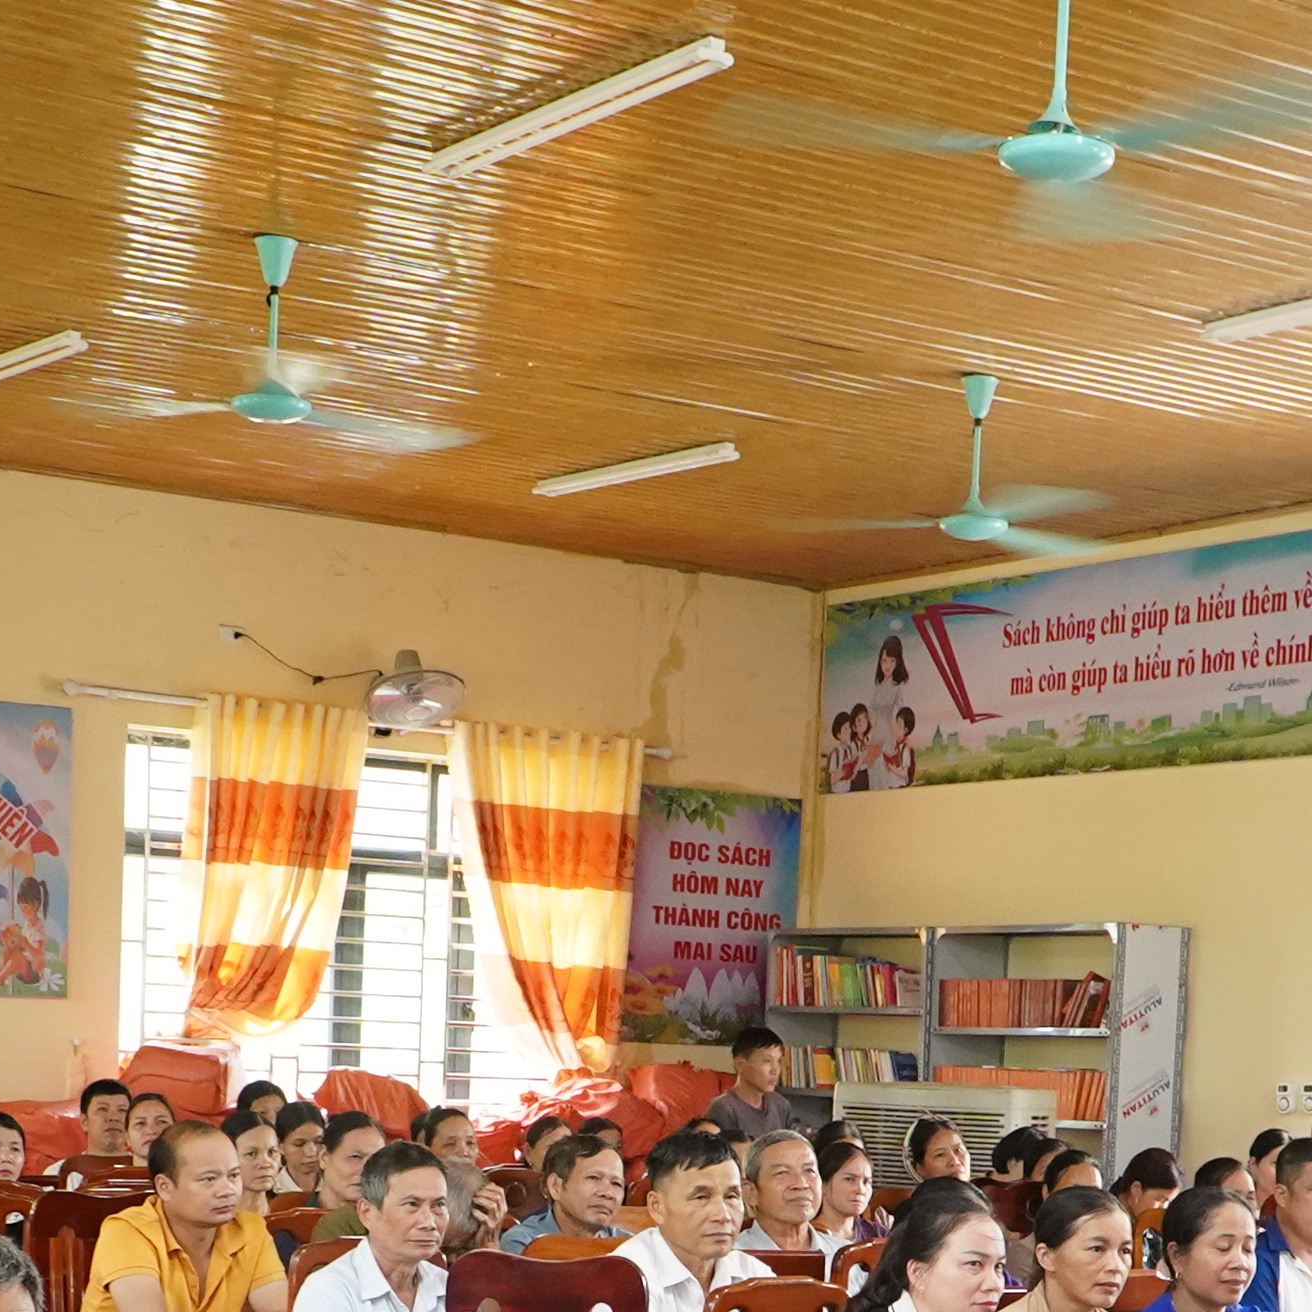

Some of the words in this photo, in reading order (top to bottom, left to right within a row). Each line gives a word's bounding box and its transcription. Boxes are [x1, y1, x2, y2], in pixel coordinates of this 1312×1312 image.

[1002, 620, 1040, 649] Sách
[1045, 612, 1096, 645] không
[1100, 604, 1127, 636] chỉ
[1131, 601, 1169, 639] giúp
[1174, 601, 1190, 626] ta
[1196, 583, 1236, 623] hiểu
[1242, 584, 1287, 617] thêm
[1293, 571, 1312, 610] về
[1010, 668, 1033, 696] mà
[1038, 665, 1067, 693] còn
[1071, 659, 1107, 696] giúp
[1113, 660, 1128, 684] ta
[1133, 644, 1171, 682] hiểu
[1177, 649, 1195, 677] rõ
[1201, 648, 1235, 675] hơn
[1241, 632, 1260, 670] về
[669, 841, 710, 865] ĐỌC
[717, 842, 771, 867] SÁCH
[672, 870, 718, 895] HÔM
[725, 878, 764, 898] NAY
[652, 903, 720, 929] THÀNH
[726, 908, 781, 932] CÔNG
[673, 941, 712, 961] MAI
[719, 944, 758, 965] SAU
[1122, 1080, 1170, 1119] ALUTITAN
